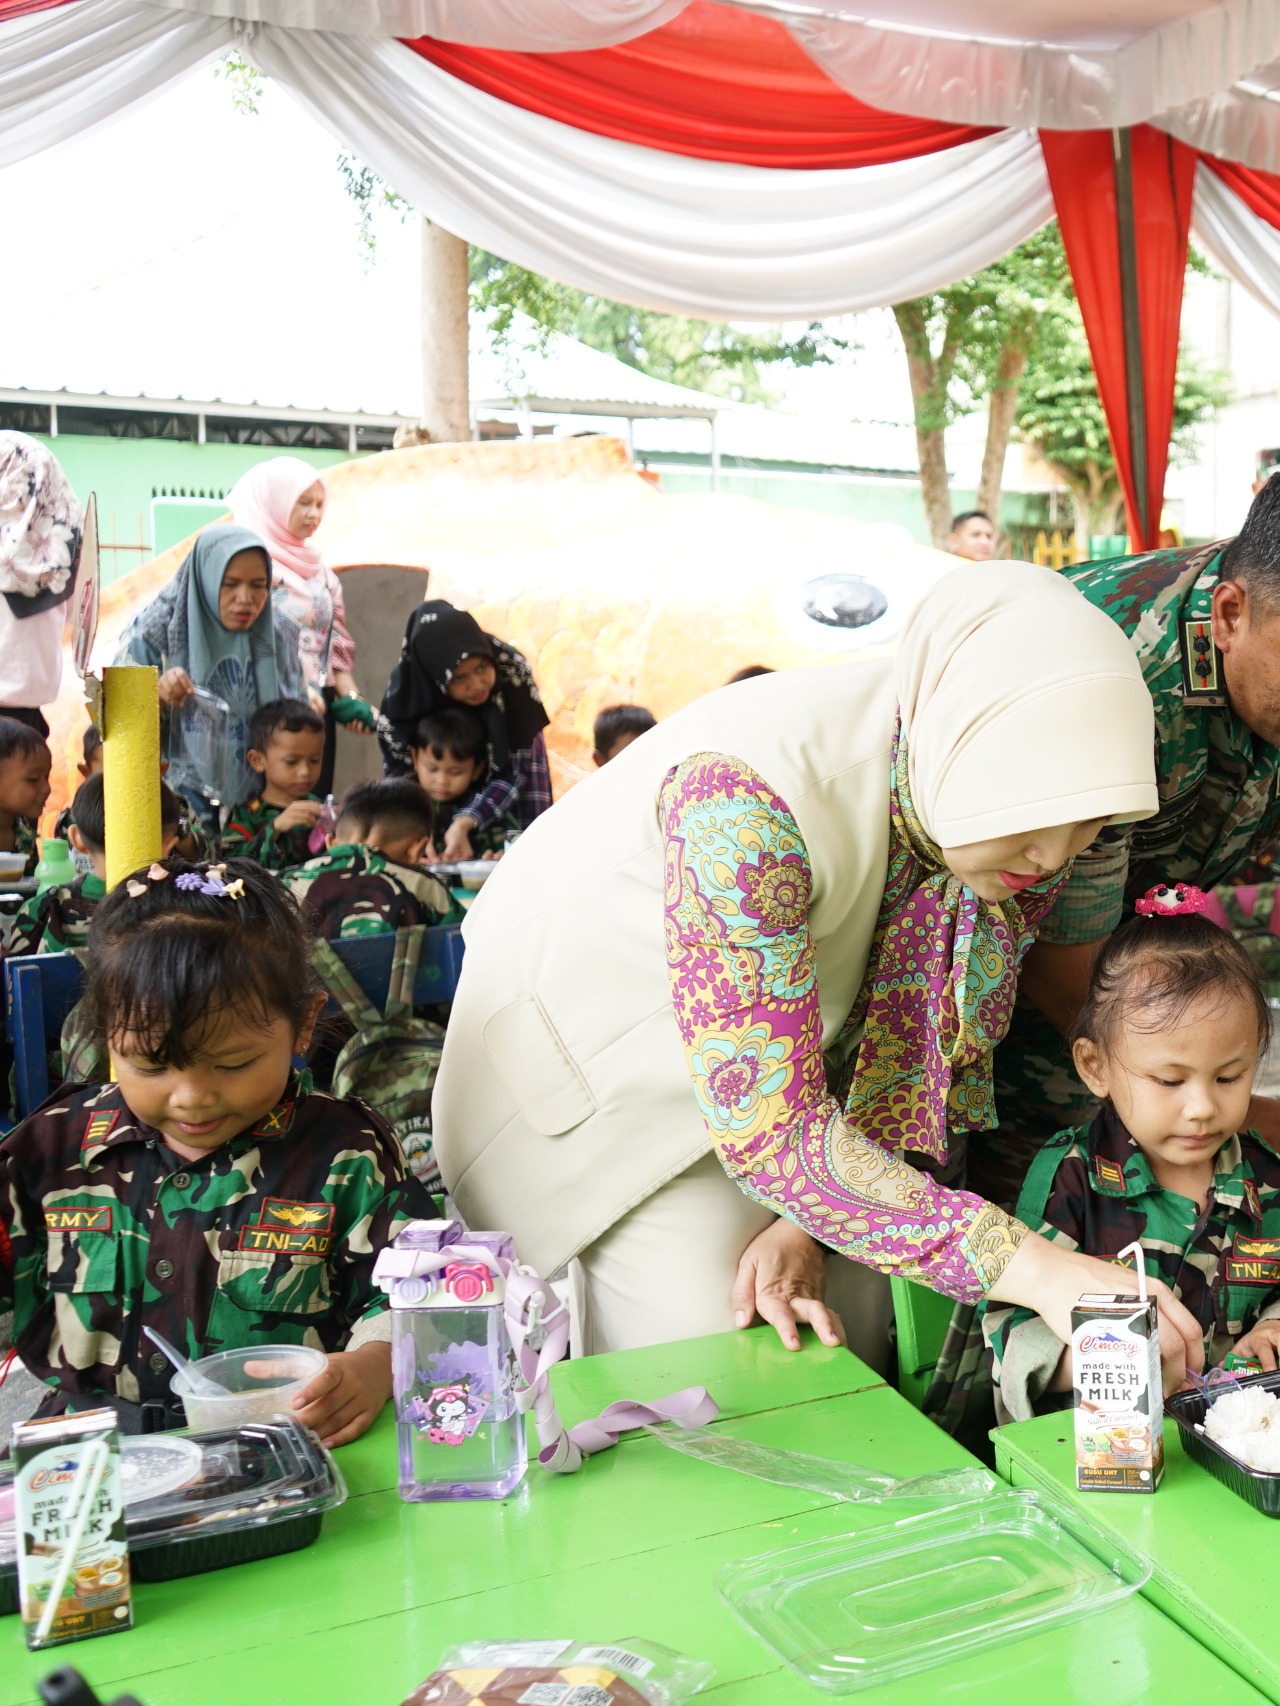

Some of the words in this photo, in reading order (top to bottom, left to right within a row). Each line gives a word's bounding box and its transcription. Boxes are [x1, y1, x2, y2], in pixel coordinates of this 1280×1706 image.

[46, 1211, 101, 1228] RMY
[251, 1230, 329, 1253] TNI-AD
[1079, 1335, 1139, 1358] Cimory
[1115, 1363, 1136, 1371] with
[1080, 1372, 1139, 1385] FRESH
[1089, 1388, 1132, 1401] MILK
[34, 1495, 70, 1509] mad
[44, 1518, 104, 1542] MIK
